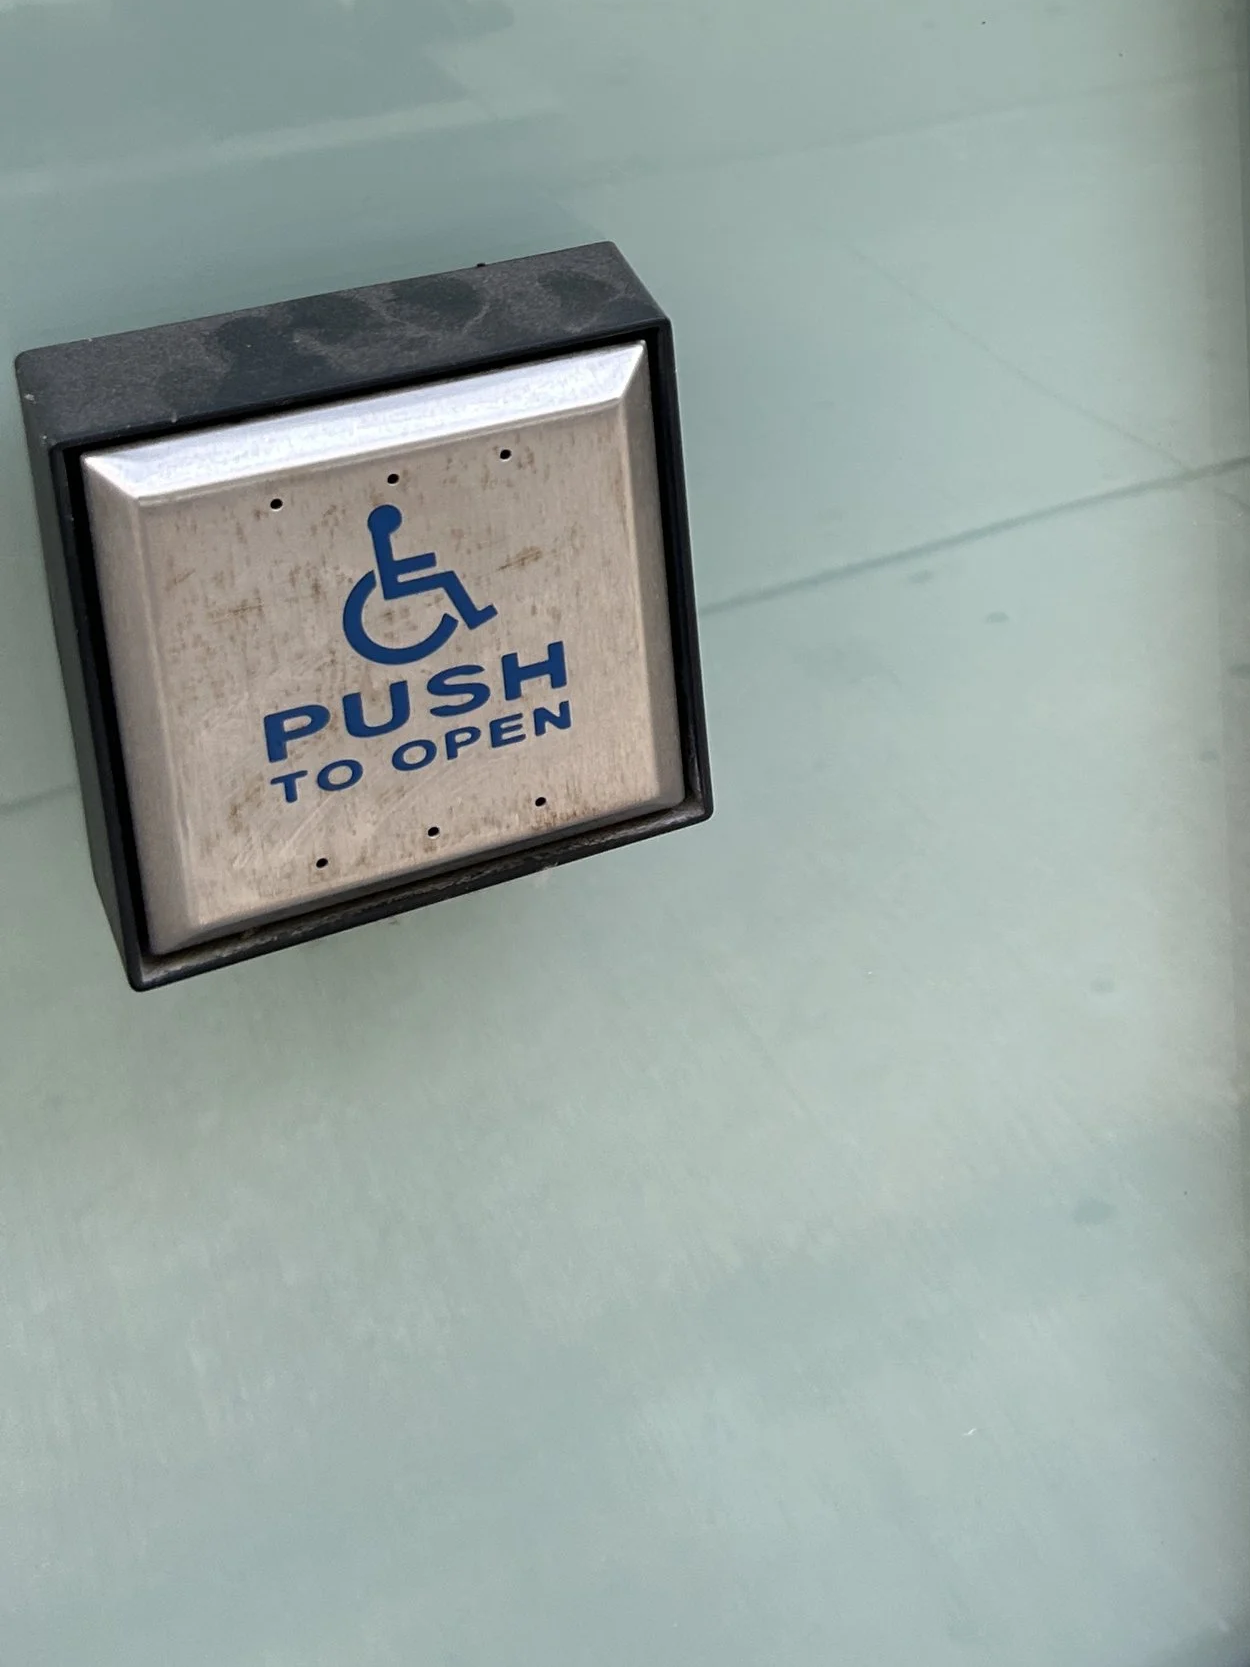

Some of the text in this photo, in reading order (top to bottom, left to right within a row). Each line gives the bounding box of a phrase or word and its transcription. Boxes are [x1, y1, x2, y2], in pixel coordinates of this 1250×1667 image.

[264, 641, 568, 763] PUSH
[271, 700, 573, 803] TO OPEN
